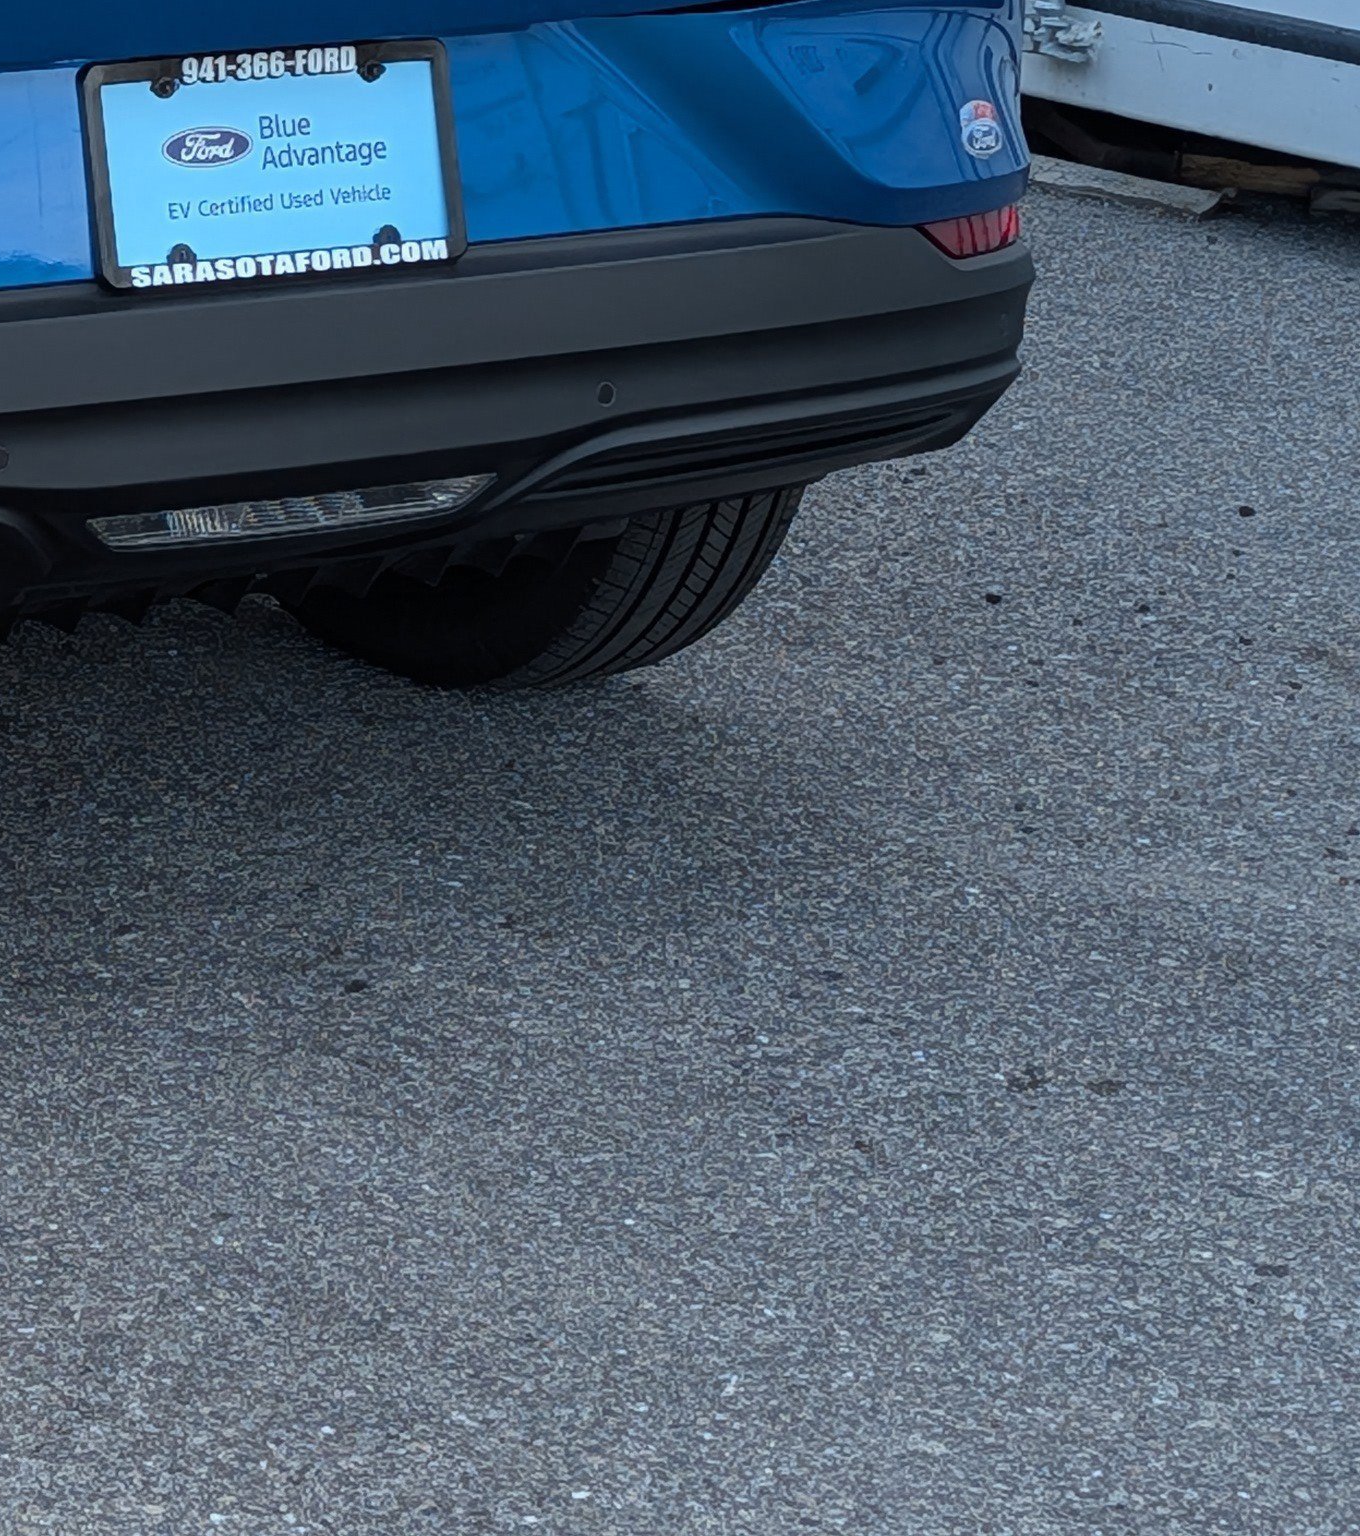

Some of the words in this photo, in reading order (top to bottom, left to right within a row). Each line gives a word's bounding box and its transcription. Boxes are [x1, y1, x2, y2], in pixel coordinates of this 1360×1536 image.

[181, 45, 357, 85] 941-366-FORD
[180, 132, 236, 162] Ford
[258, 114, 312, 140] Blue
[261, 139, 388, 170] Advantage
[167, 201, 192, 221] EV
[197, 194, 274, 218] Certified
[279, 189, 324, 211] Used
[330, 183, 392, 206] Vehicle
[130, 238, 449, 289] SARASOTAFORD.COM
